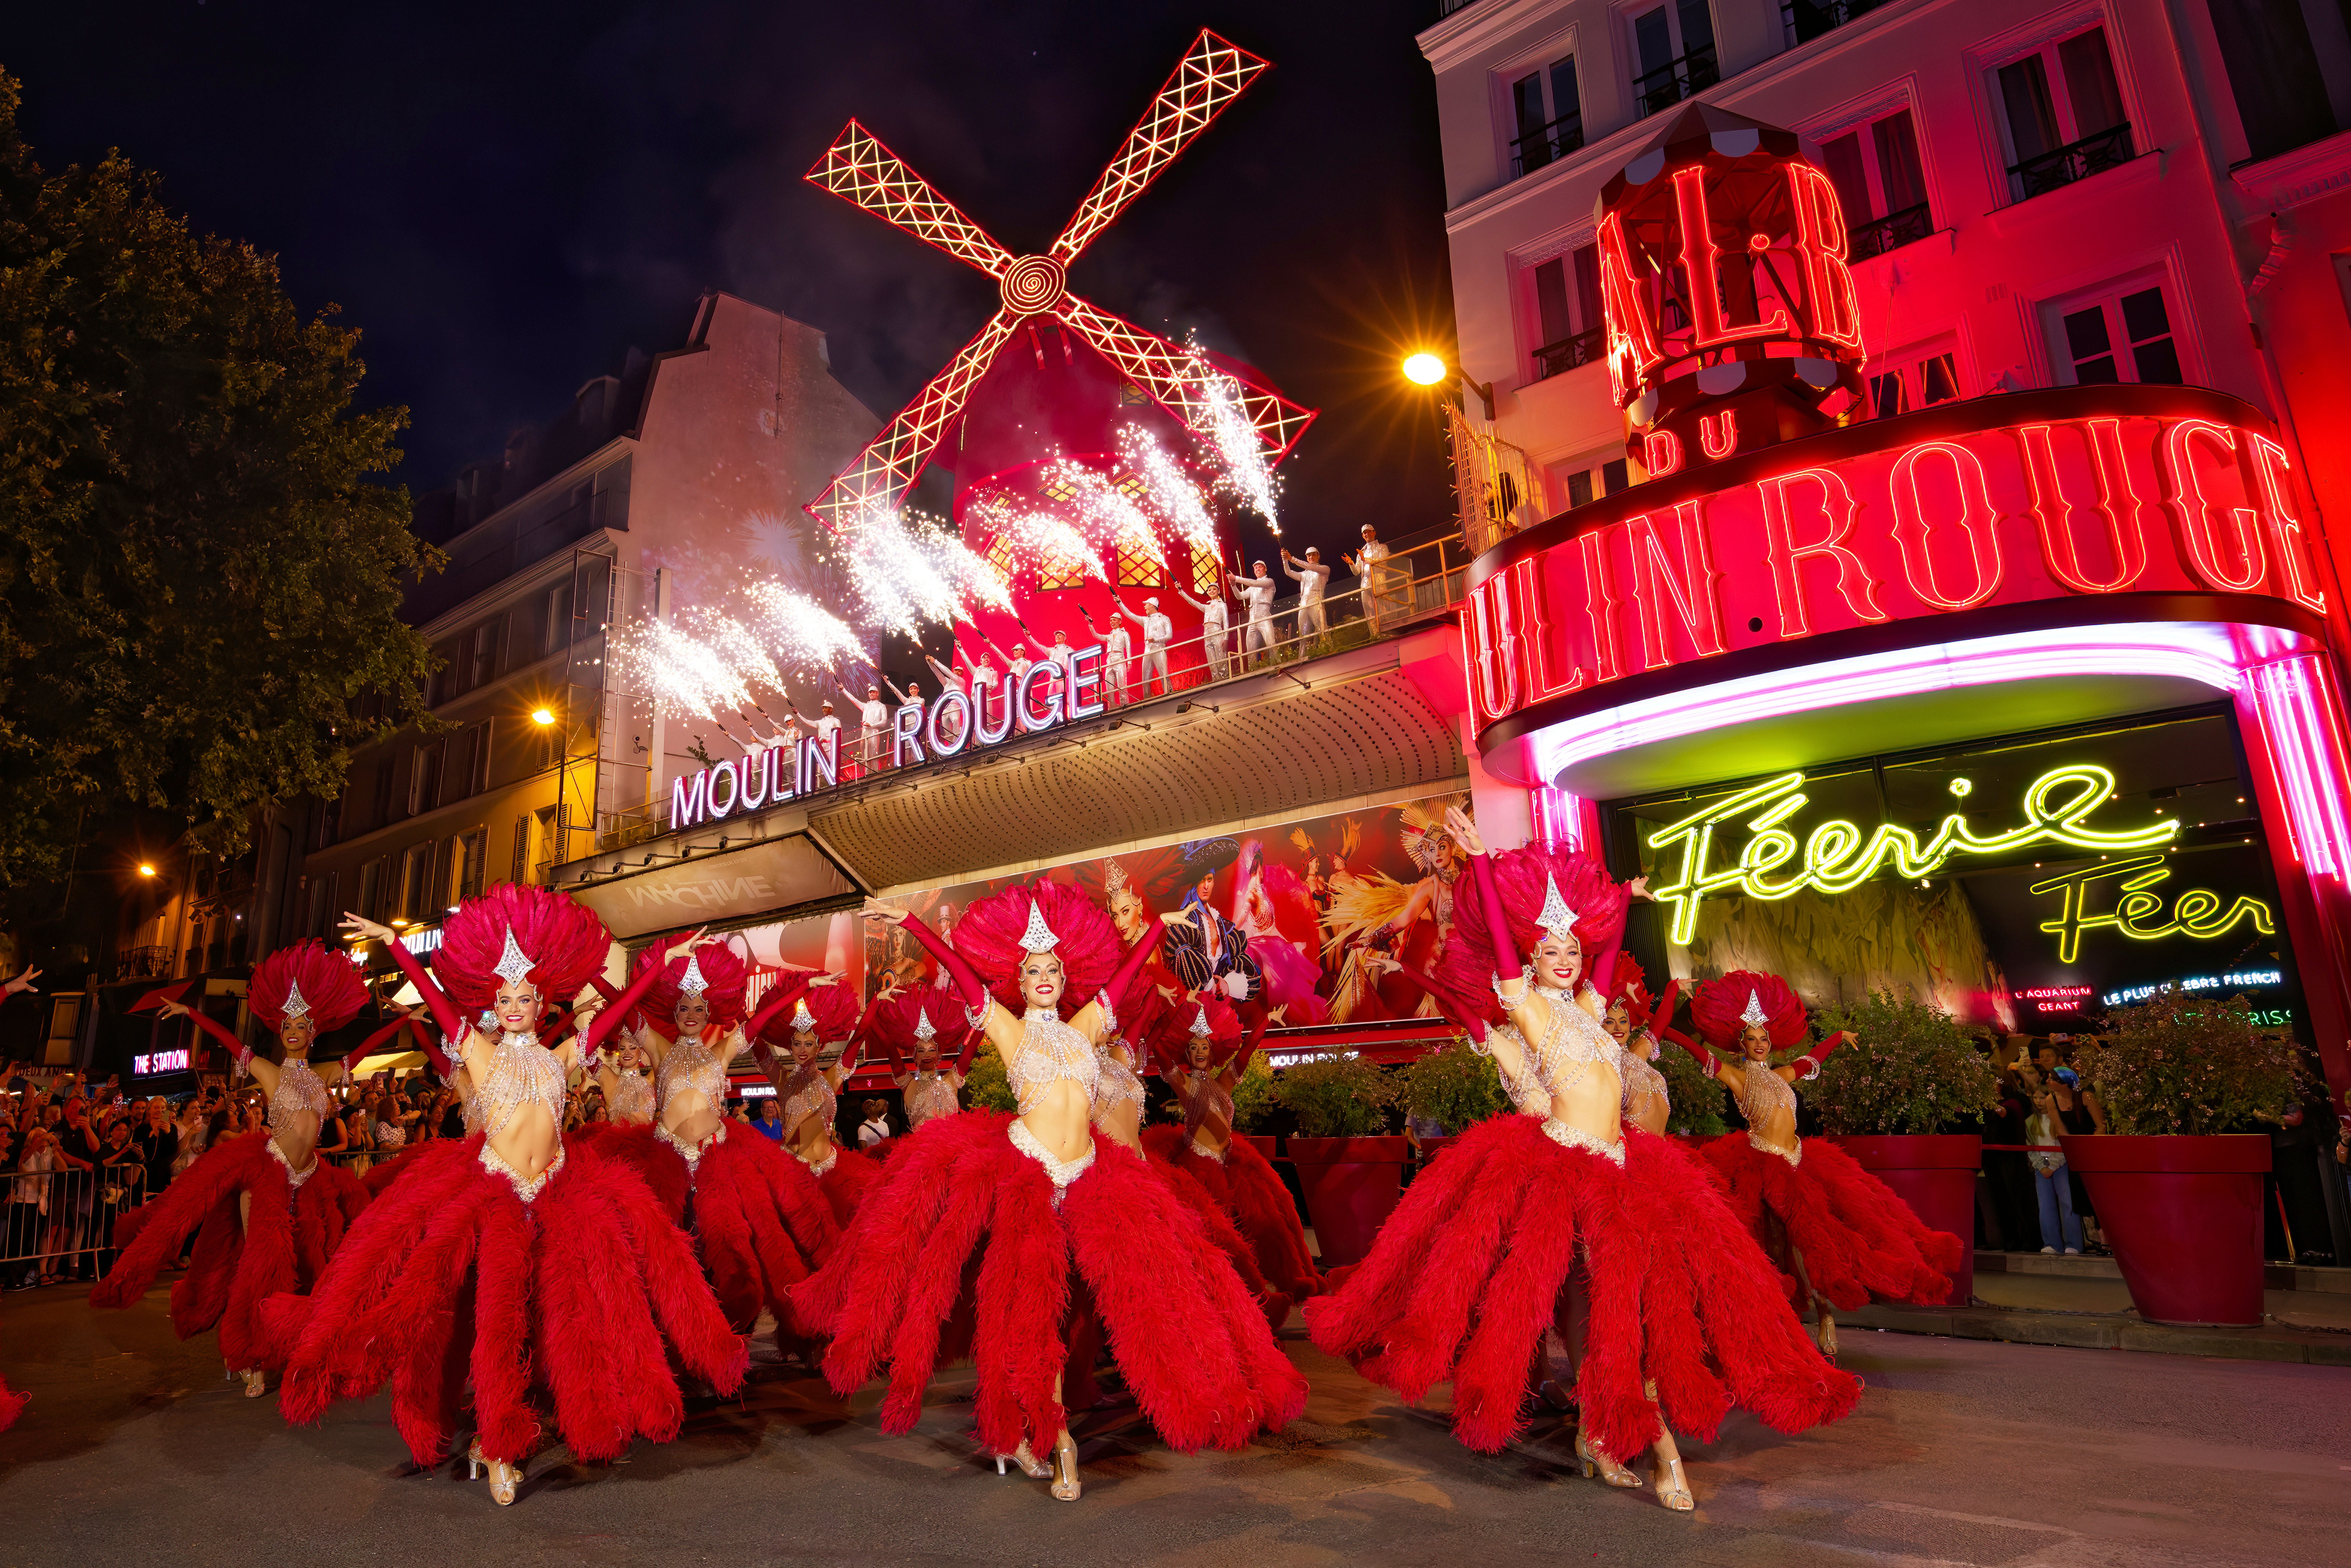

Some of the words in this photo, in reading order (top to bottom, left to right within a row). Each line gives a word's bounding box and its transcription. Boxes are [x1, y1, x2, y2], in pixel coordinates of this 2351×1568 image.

[1644, 409, 1738, 476] DU
[1460, 500, 1725, 740] ULIN
[1757, 419, 2327, 638] ROUGE
[671, 727, 841, 829] MOULIN
[894, 644, 1105, 767] ROUGE
[1649, 765, 2181, 946] Féerie
[2038, 1001, 2080, 1011] GEANT
[2103, 993, 2121, 1005] LE
[2224, 972, 2280, 985] FRENCH
[135, 1054, 150, 1074] THE
[152, 1049, 188, 1073] STATION
[741, 1087, 765, 1096] MOULIN
